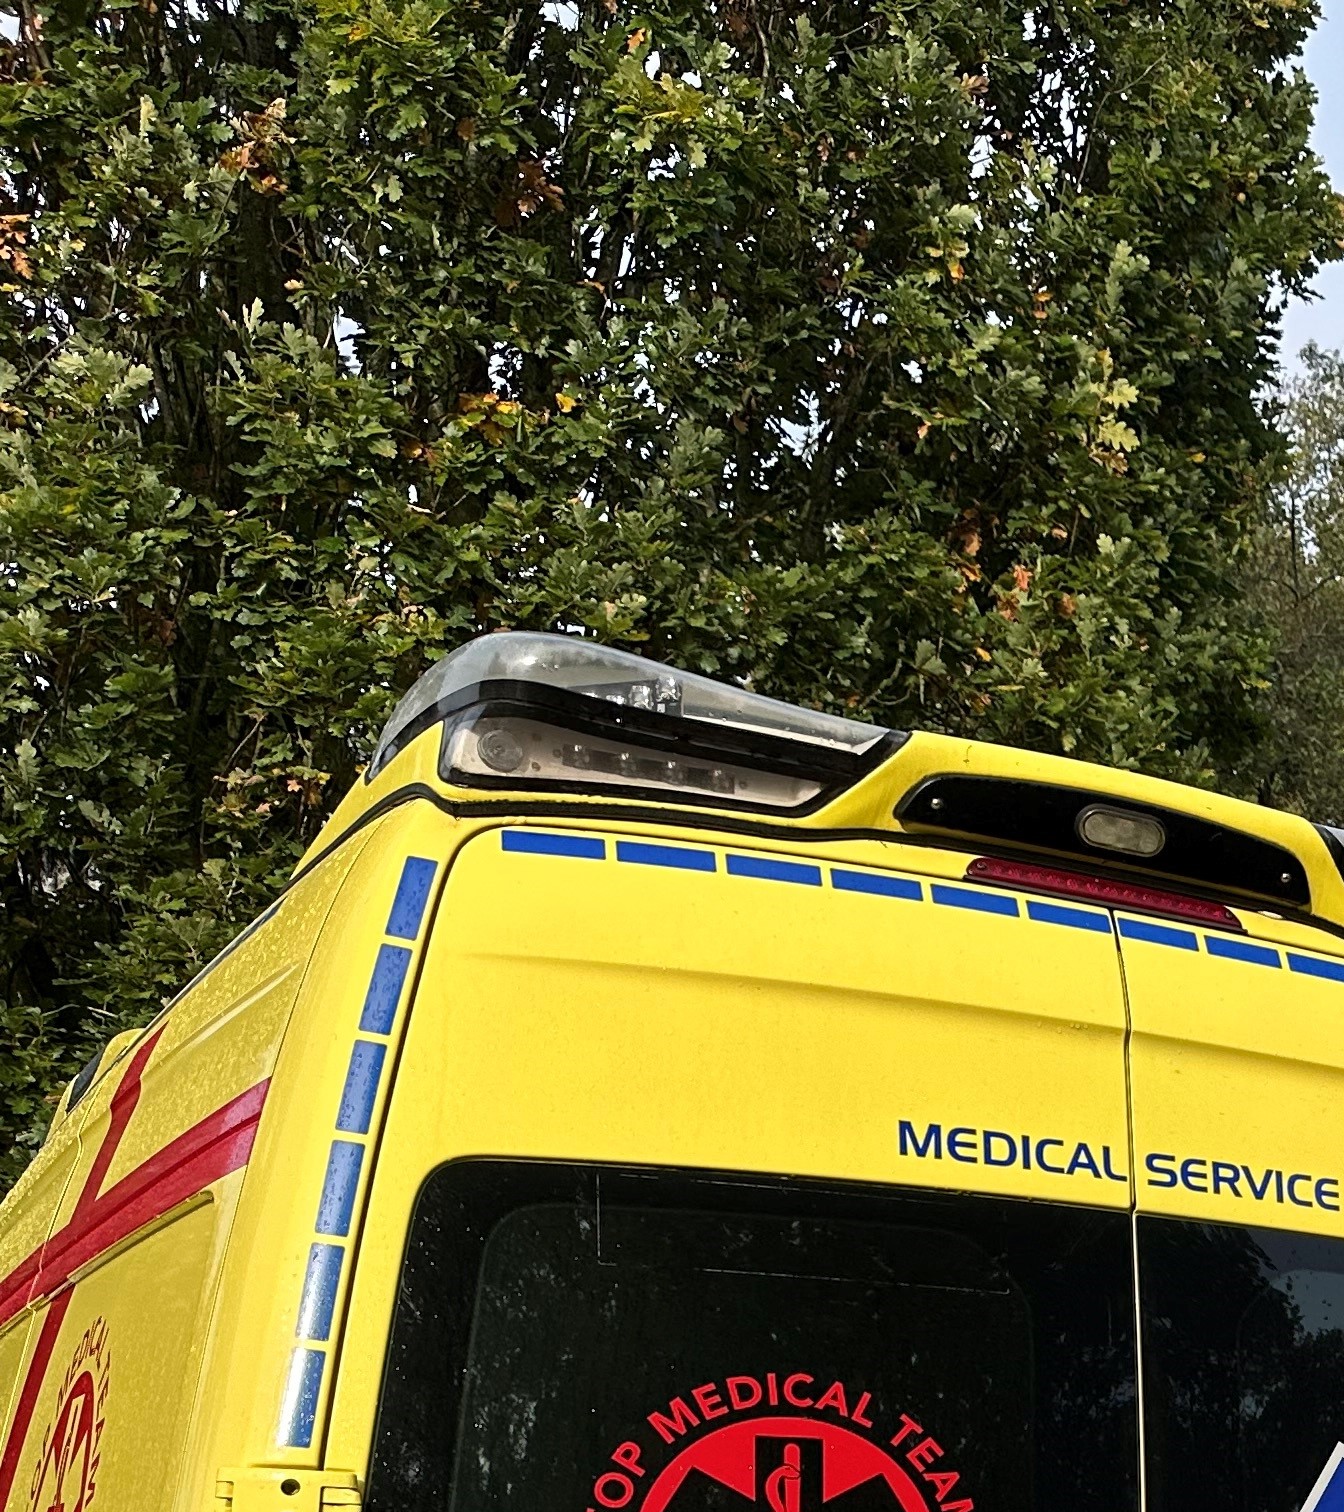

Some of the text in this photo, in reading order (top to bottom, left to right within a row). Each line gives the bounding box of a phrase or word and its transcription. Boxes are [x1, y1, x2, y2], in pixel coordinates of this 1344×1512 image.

[898, 1119, 1341, 1212] MEDICAL SERVICE
[646, 1373, 874, 1444] MEDICAL
